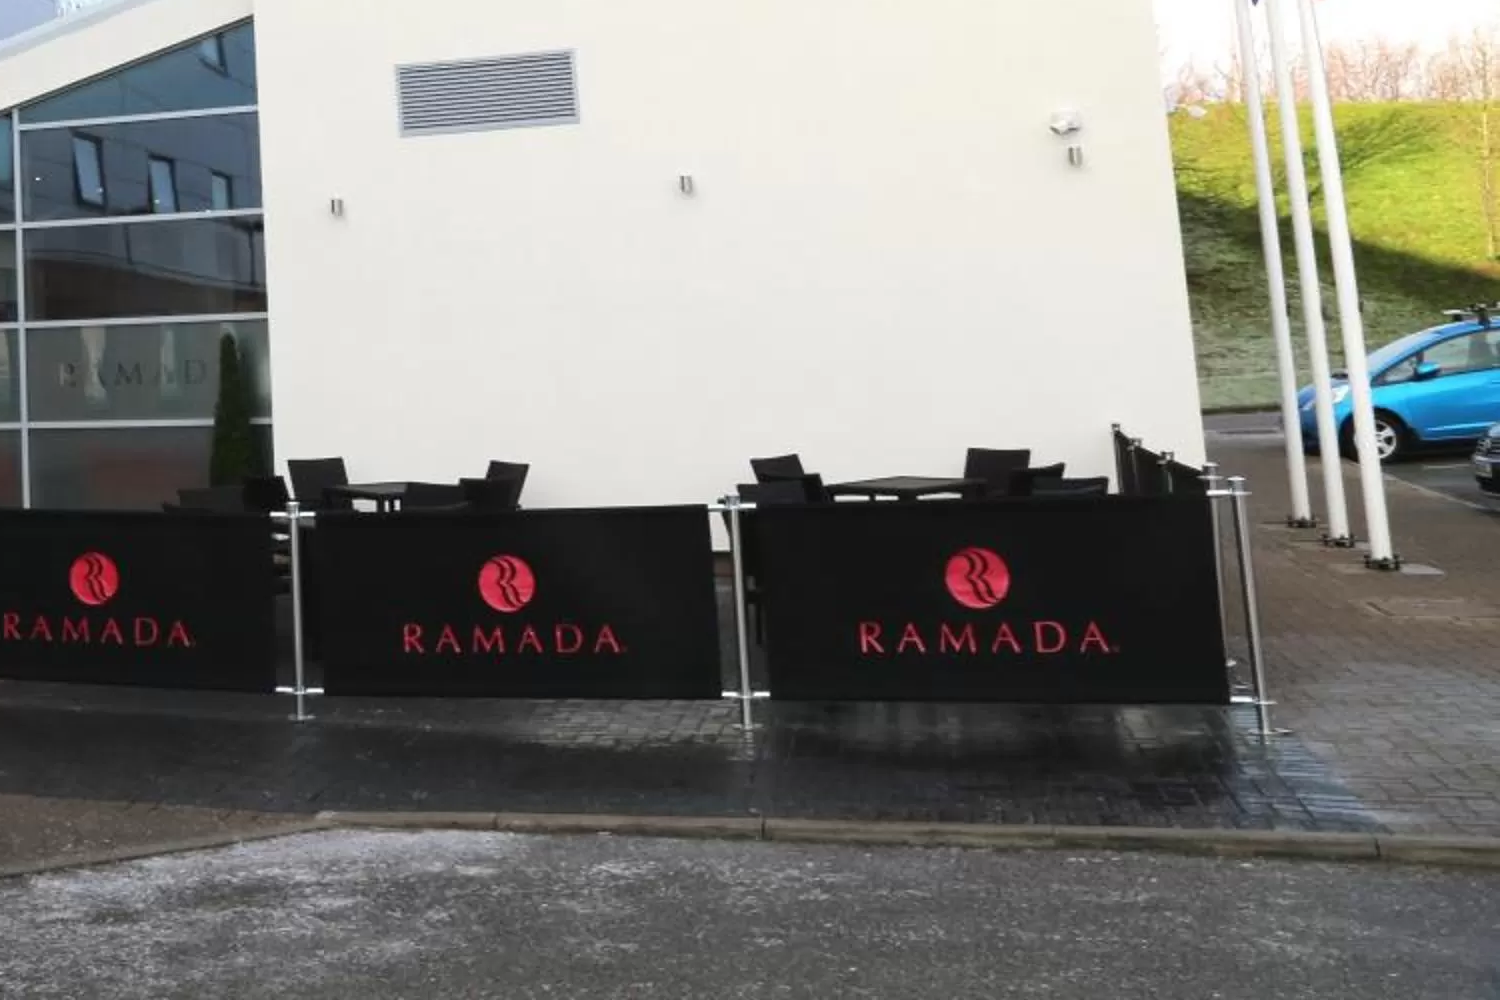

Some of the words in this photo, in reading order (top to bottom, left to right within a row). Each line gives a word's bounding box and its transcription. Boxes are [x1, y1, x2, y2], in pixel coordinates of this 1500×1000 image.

[2, 611, 193, 648] RAMADA
[402, 623, 623, 654] RAMADA
[858, 620, 1112, 654] RAMADA
